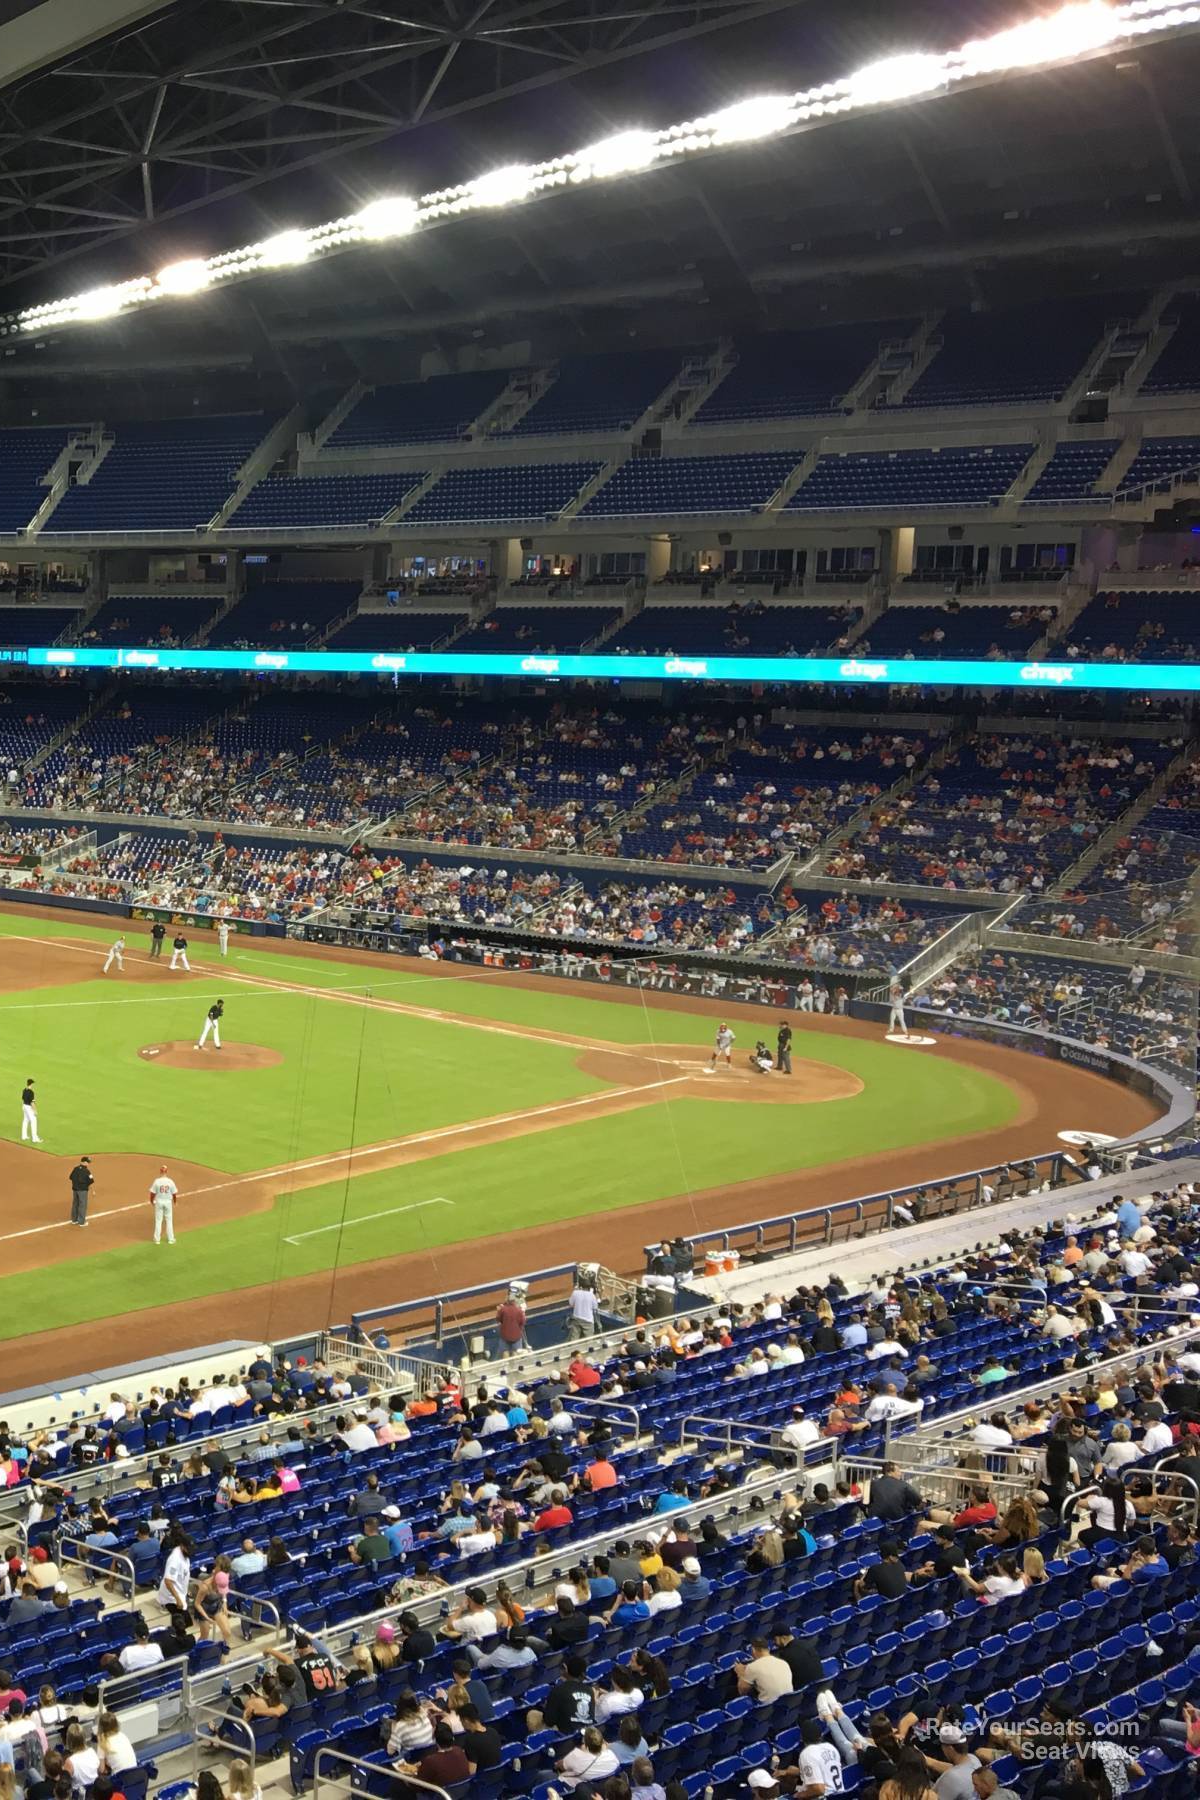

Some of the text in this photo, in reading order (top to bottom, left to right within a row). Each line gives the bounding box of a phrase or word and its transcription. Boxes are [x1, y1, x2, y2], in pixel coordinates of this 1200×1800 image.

[666, 657, 707, 676] citrix
[840, 659, 887, 680] citrix
[1021, 662, 1073, 682] citrix
[311, 1667, 334, 1690] 51
